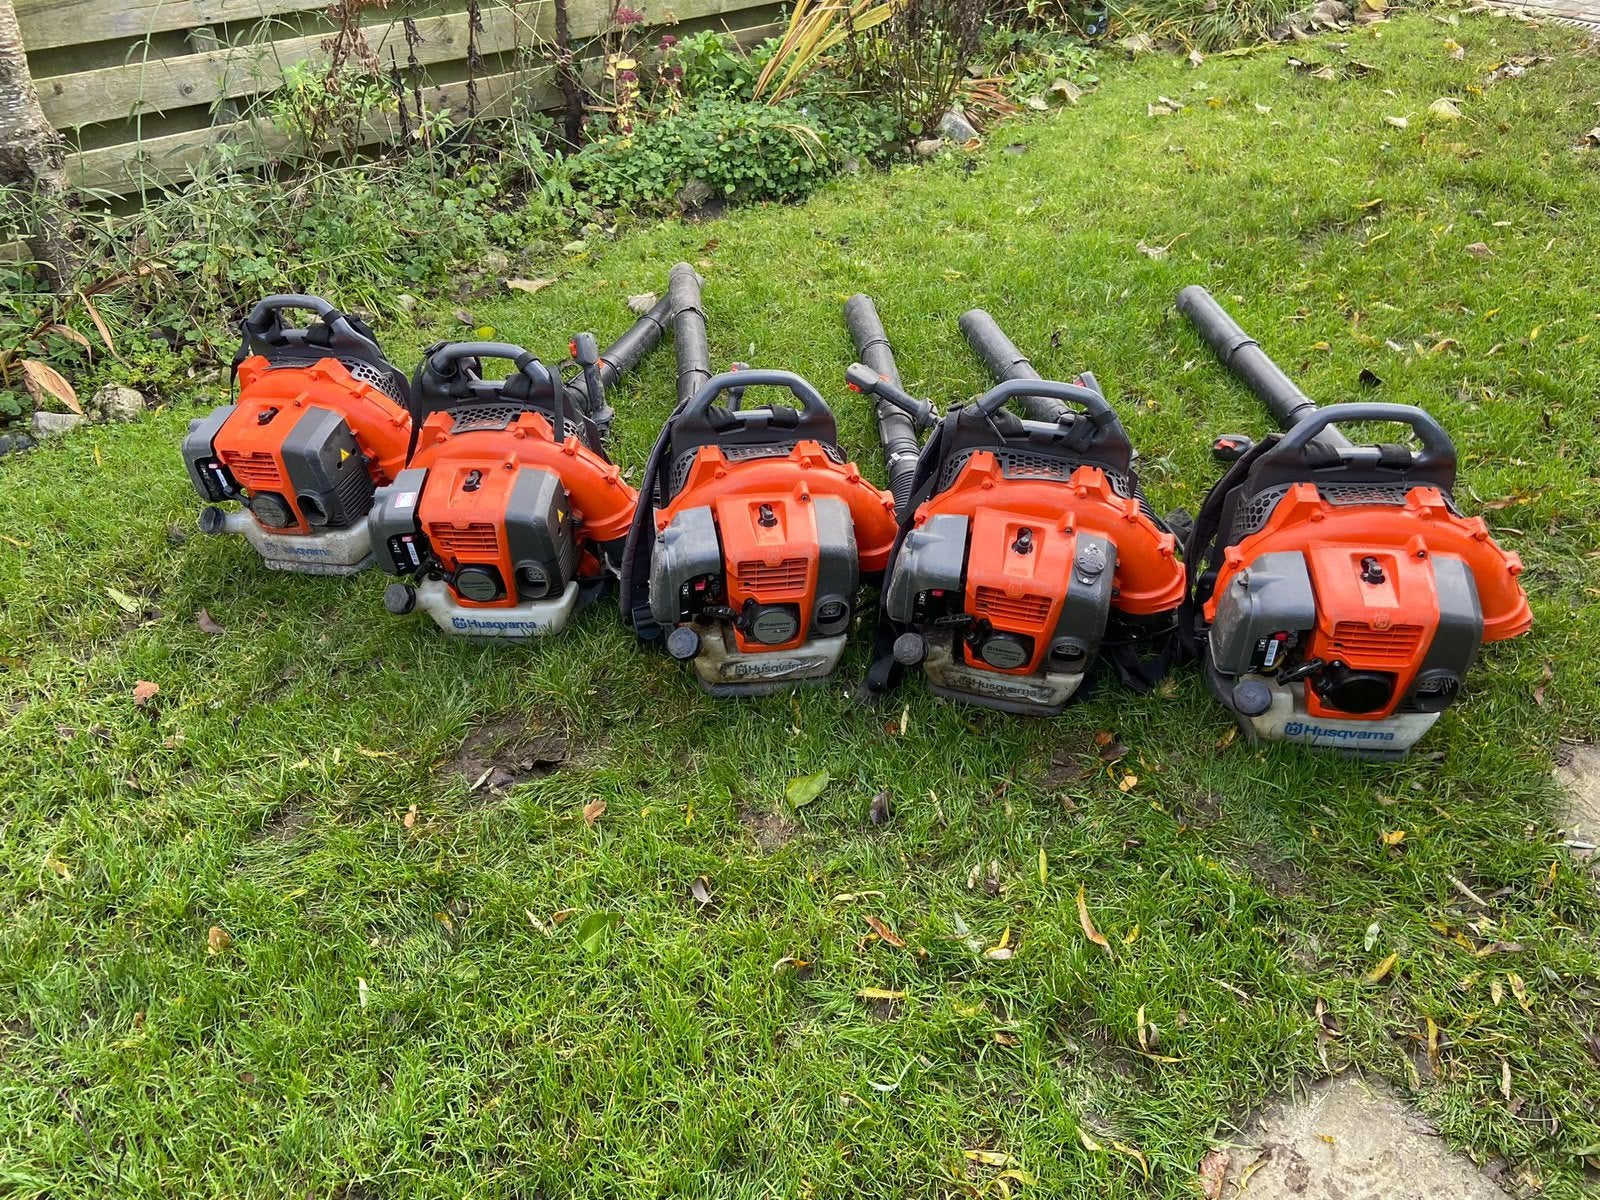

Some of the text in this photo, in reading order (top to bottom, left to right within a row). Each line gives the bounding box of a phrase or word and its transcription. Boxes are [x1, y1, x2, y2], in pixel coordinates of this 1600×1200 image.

[466, 619, 537, 630] Husqvarna
[748, 662, 806, 675] Husqvarn
[1304, 725, 1395, 740] Husqvarna
